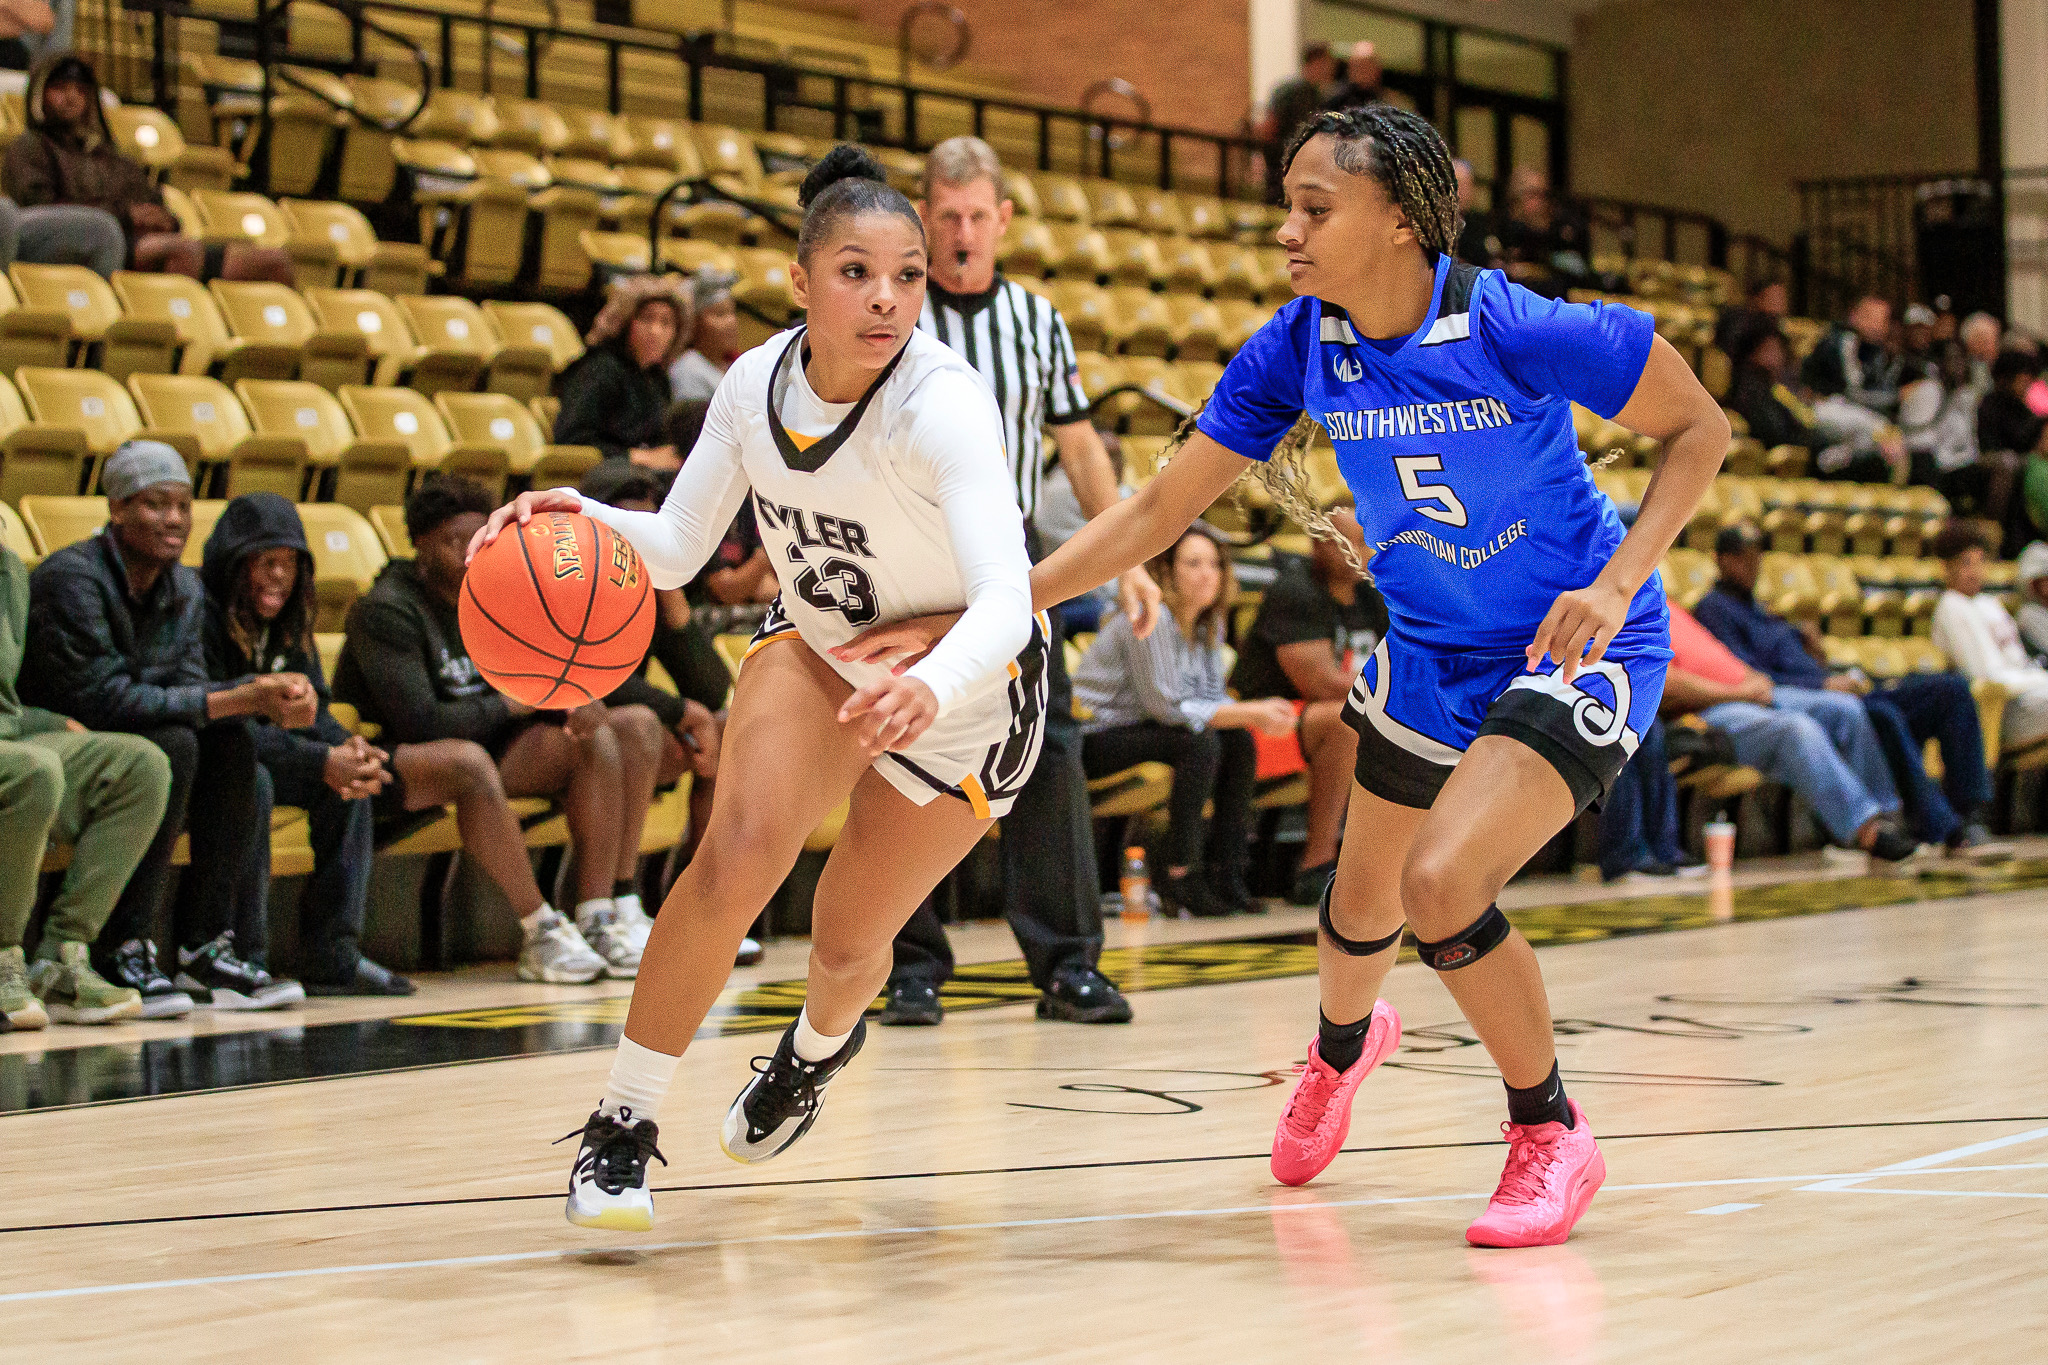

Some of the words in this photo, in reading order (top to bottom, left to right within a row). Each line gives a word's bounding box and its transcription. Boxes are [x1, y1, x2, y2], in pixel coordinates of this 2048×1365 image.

[1323, 397, 1513, 441] SOUTHWESTERN
[754, 490, 877, 559] TYLER
[1392, 453, 1468, 529] 5
[549, 512, 586, 581] SPALD
[1460, 518, 1528, 570] COLLEGE
[786, 541, 881, 628] 23
